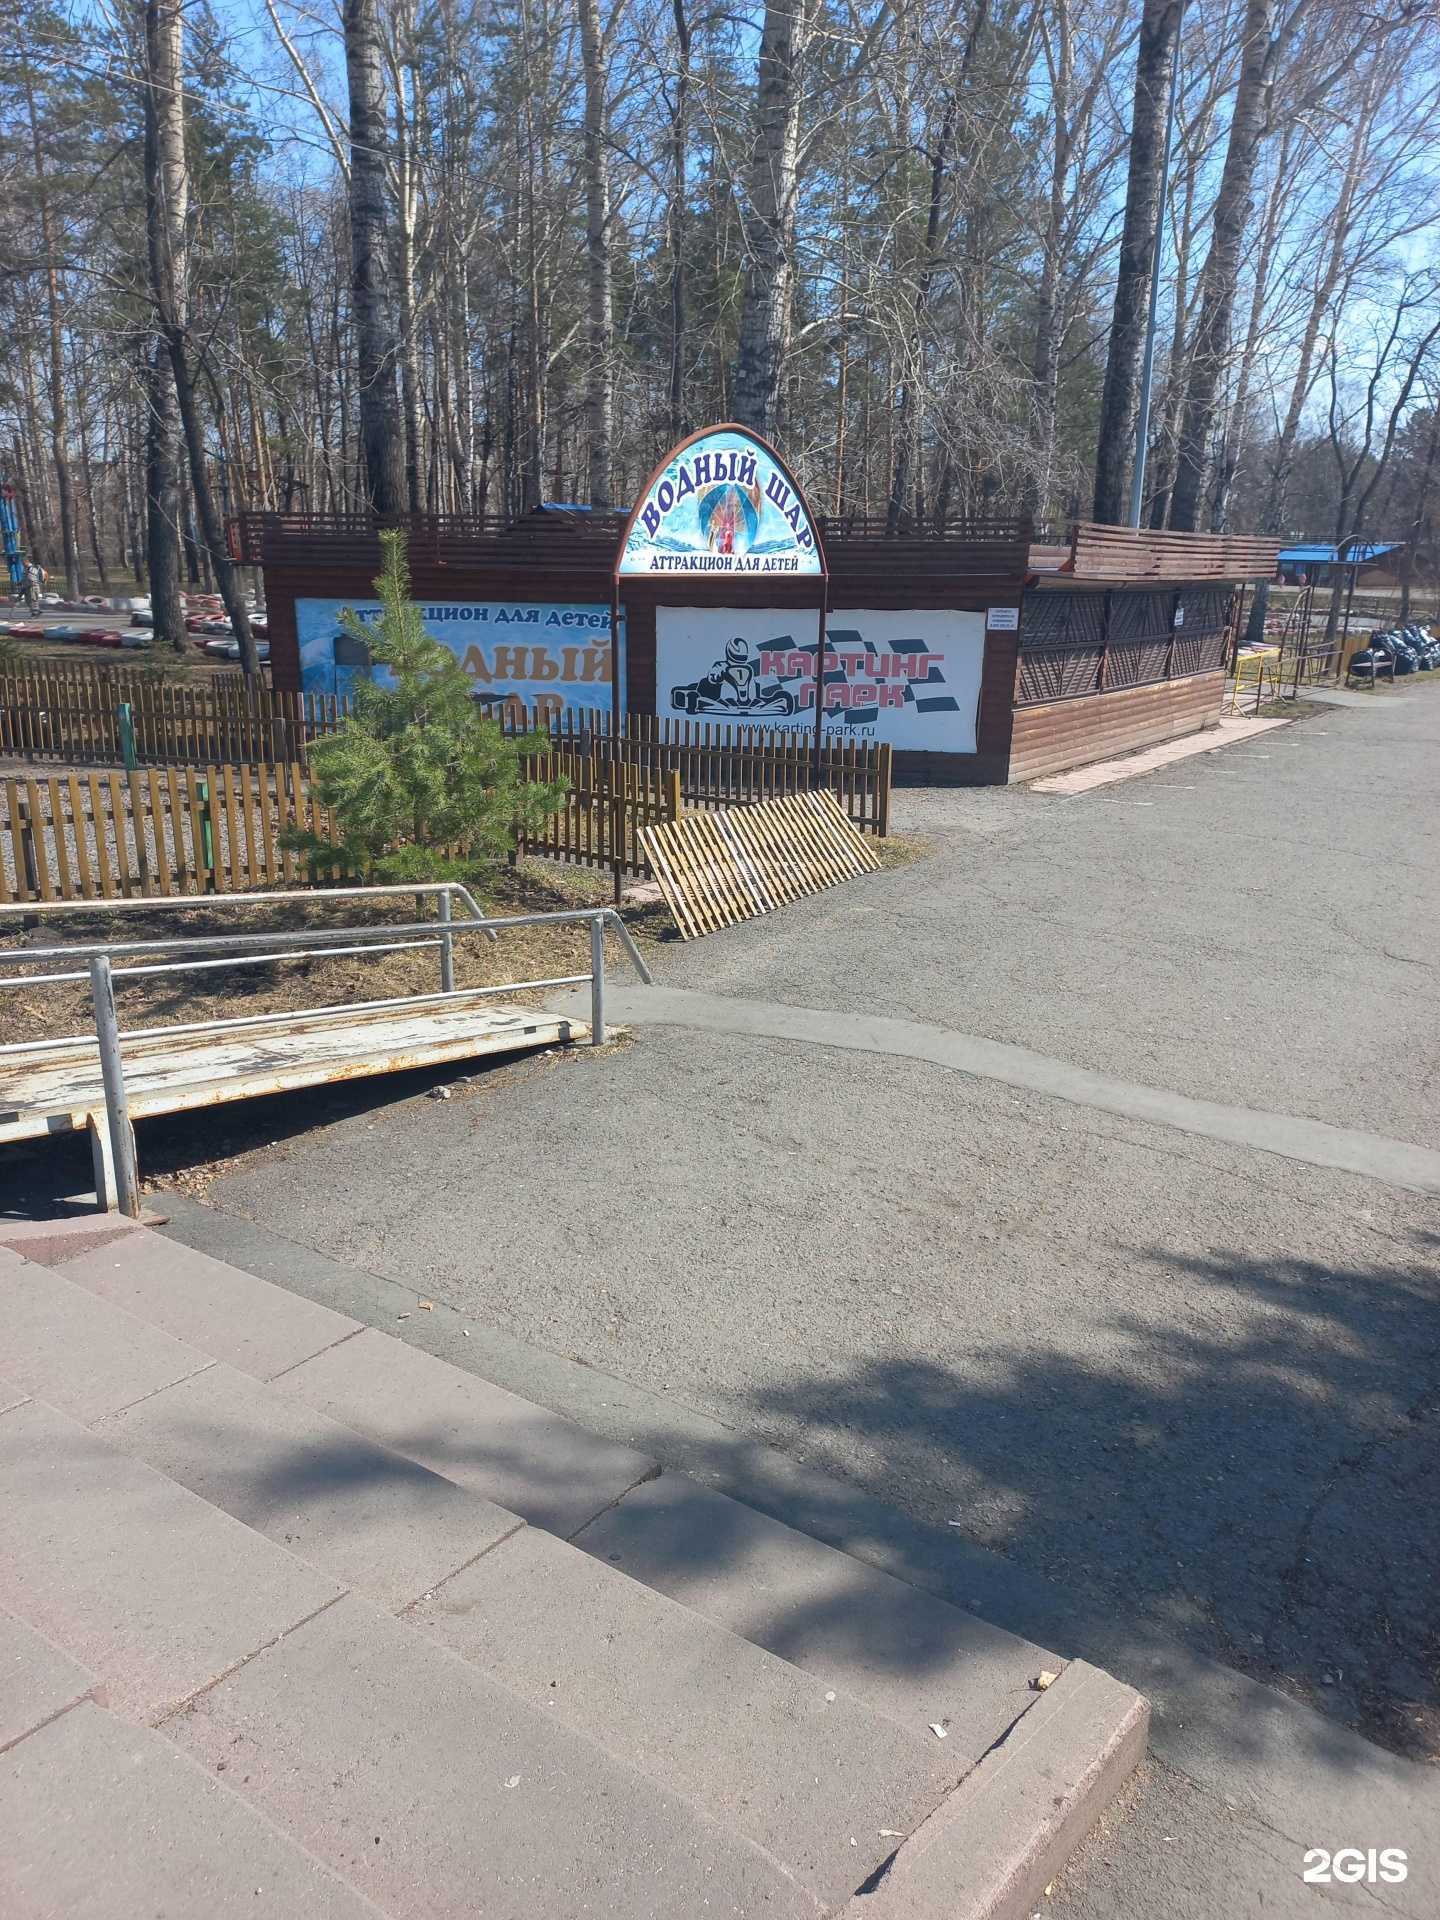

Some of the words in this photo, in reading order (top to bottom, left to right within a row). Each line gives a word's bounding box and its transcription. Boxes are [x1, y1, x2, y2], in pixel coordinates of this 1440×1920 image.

[641, 449, 757, 538] ВОДНЫЙ
[765, 472, 813, 549] ШАР
[649, 556, 733, 572] АТТРАКЦИОН
[735, 557, 760, 572] ДЛЯ
[763, 555, 799, 571] ДЕТЕЙ
[338, 606, 489, 623] тткцион
[389, 639, 613, 684] ДНЫЙ
[759, 651, 945, 679] КАРТИНГ
[799, 683, 907, 709] ПАРК
[737, 721, 876, 738] wwwkarting-park.ru
